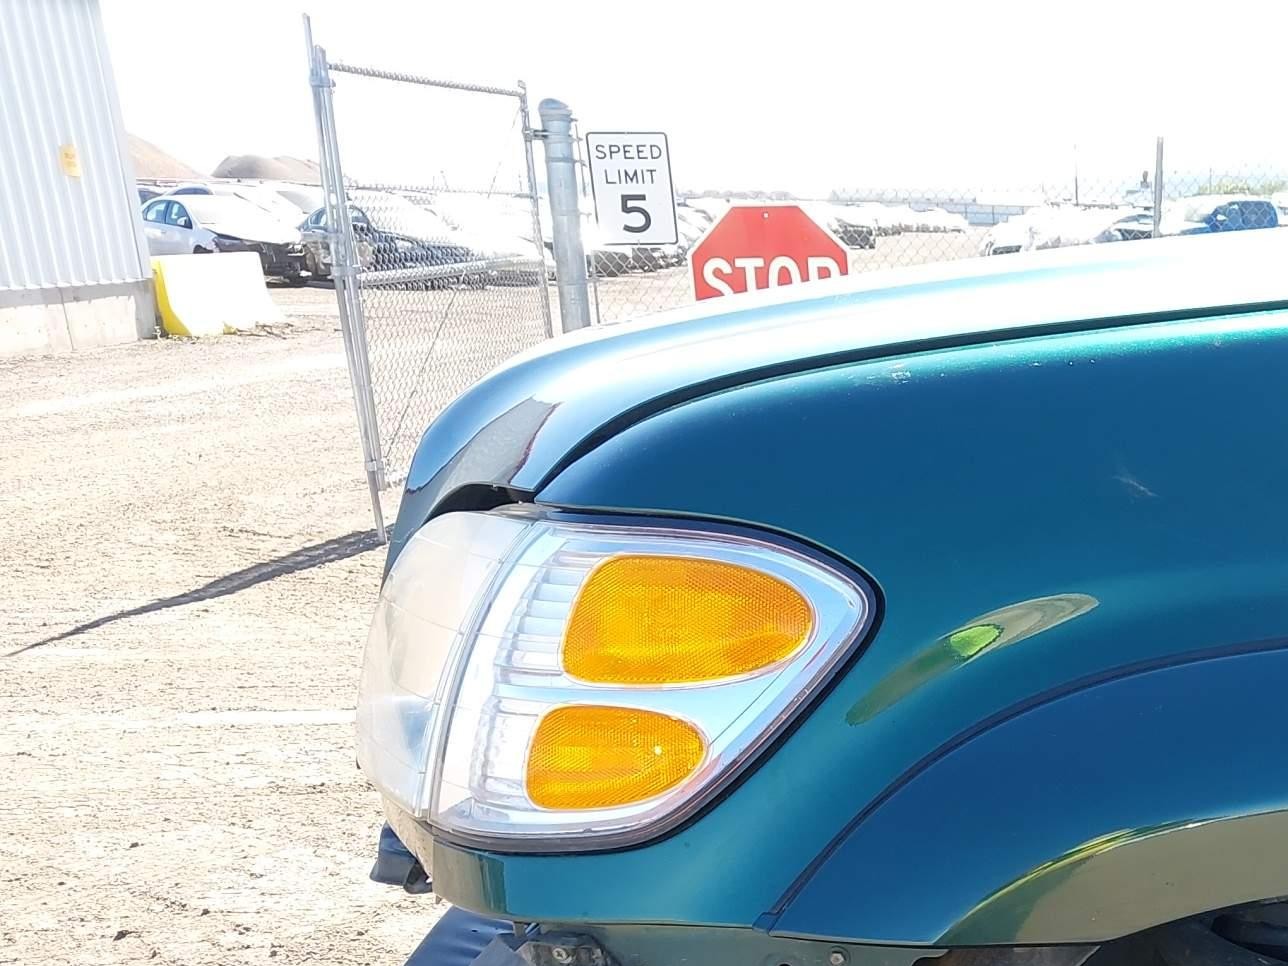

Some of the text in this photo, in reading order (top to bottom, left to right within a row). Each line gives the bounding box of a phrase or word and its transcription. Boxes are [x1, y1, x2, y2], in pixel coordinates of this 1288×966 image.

[595, 144, 662, 159] SPEED
[604, 169, 657, 184] LIMIT
[620, 194, 652, 233] 5
